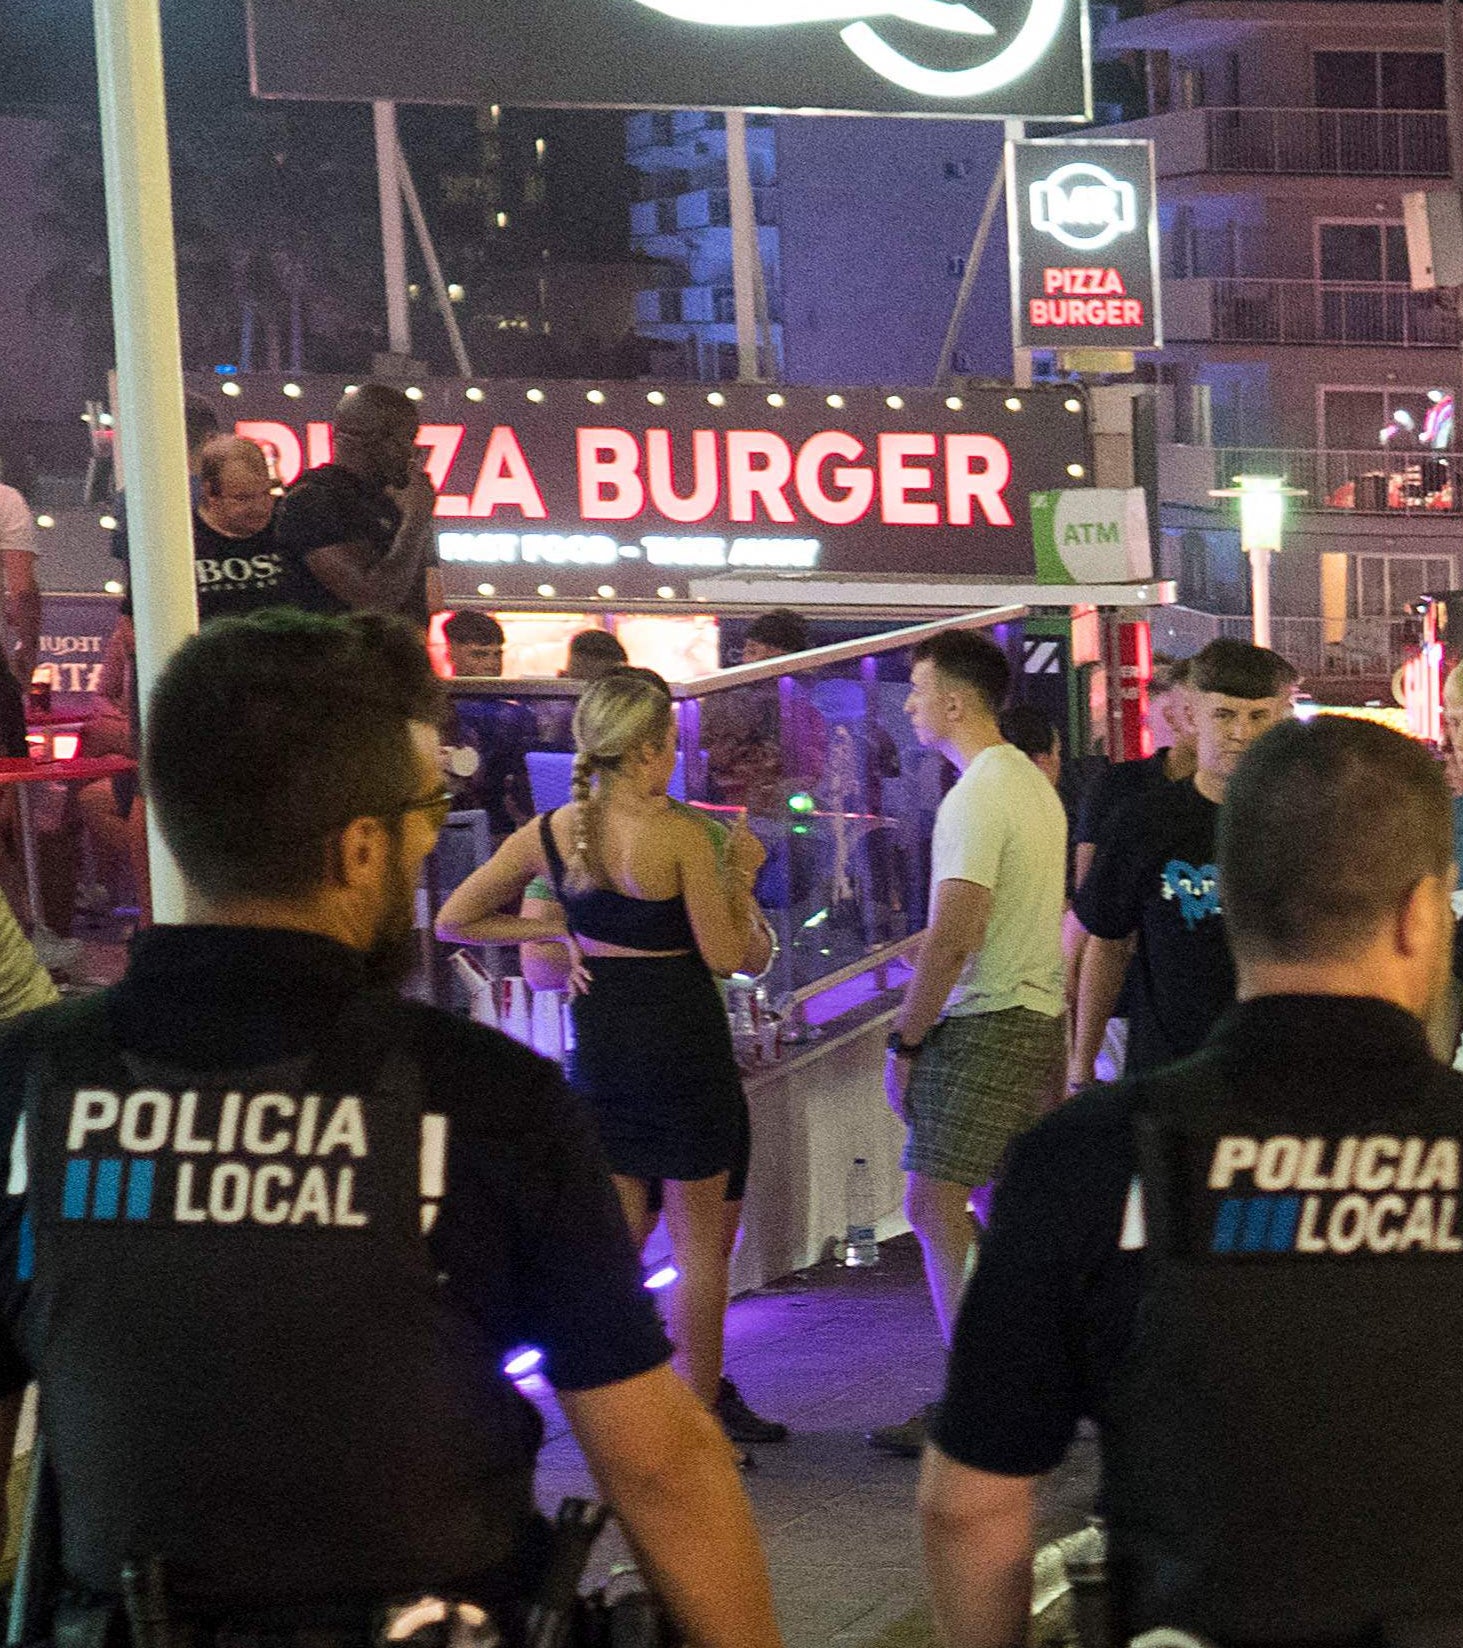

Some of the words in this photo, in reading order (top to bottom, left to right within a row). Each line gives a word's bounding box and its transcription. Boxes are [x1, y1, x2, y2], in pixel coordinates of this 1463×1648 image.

[1043, 267, 1127, 296] PIZZA
[1029, 298, 1144, 326] BURGER
[575, 426, 1015, 527] BURGER
[1063, 521, 1120, 545] ATM
[66, 1090, 368, 1157] POLICIA
[1208, 1135, 1461, 1191] POLICIA
[174, 1161, 369, 1226] LOCAL
